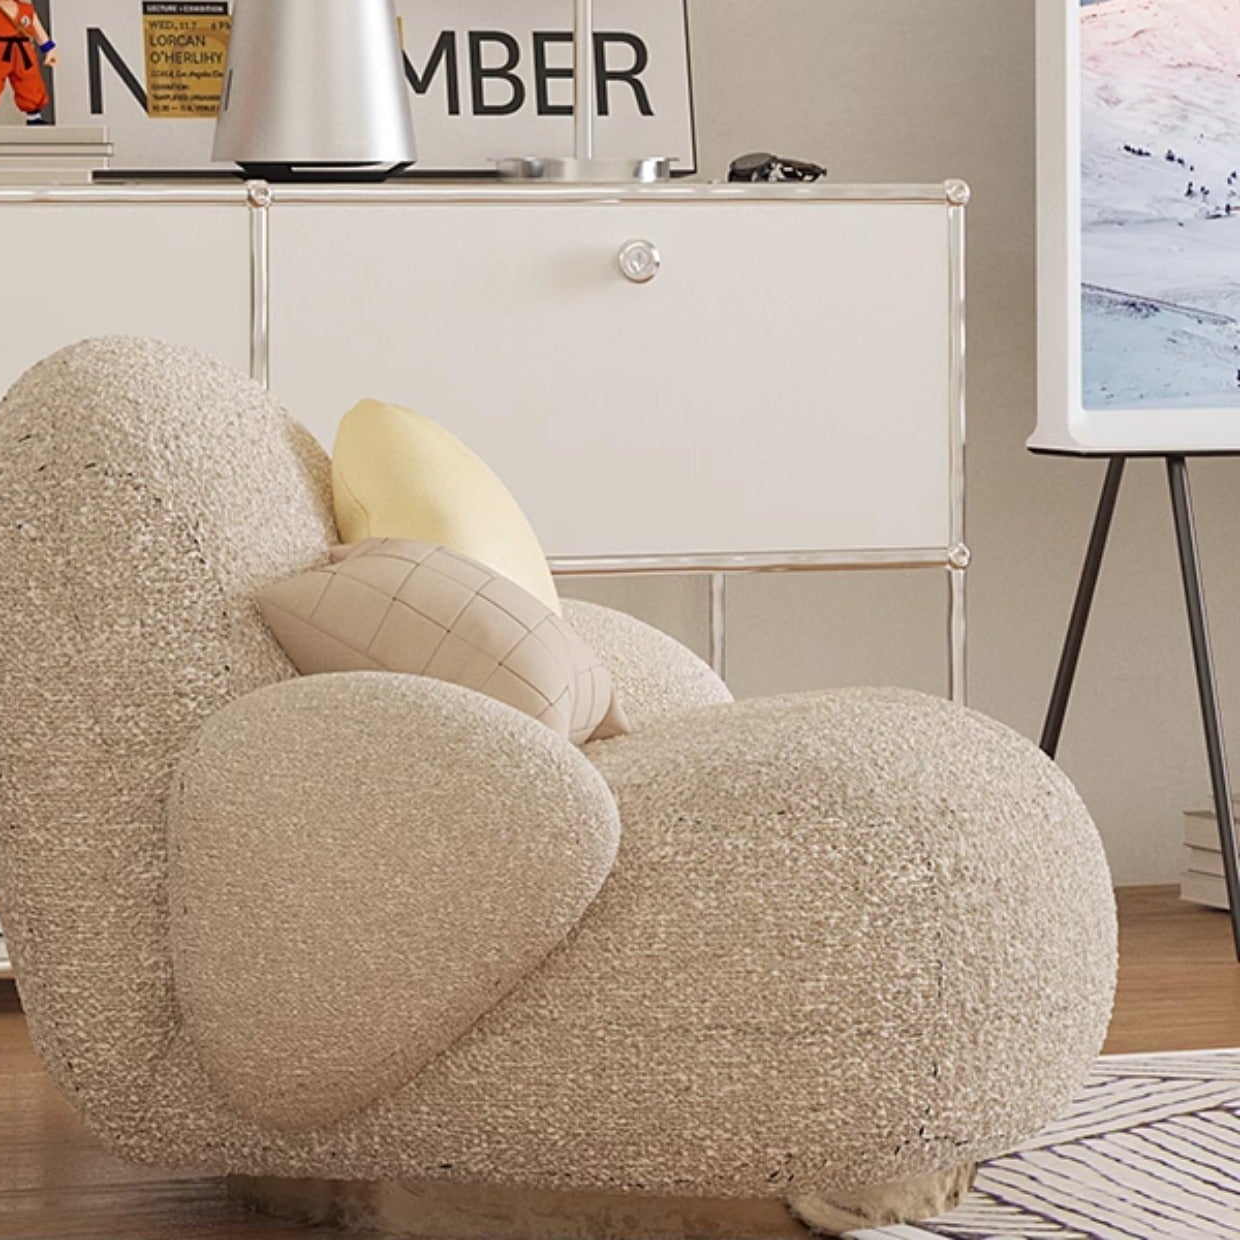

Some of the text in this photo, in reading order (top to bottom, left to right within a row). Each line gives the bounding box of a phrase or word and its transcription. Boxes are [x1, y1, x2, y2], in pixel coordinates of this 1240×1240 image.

[149, 35, 205, 47] LORCAN
[151, 51, 224, 64] O'HERLIHY
[86, 26, 655, 117] NOMBER
